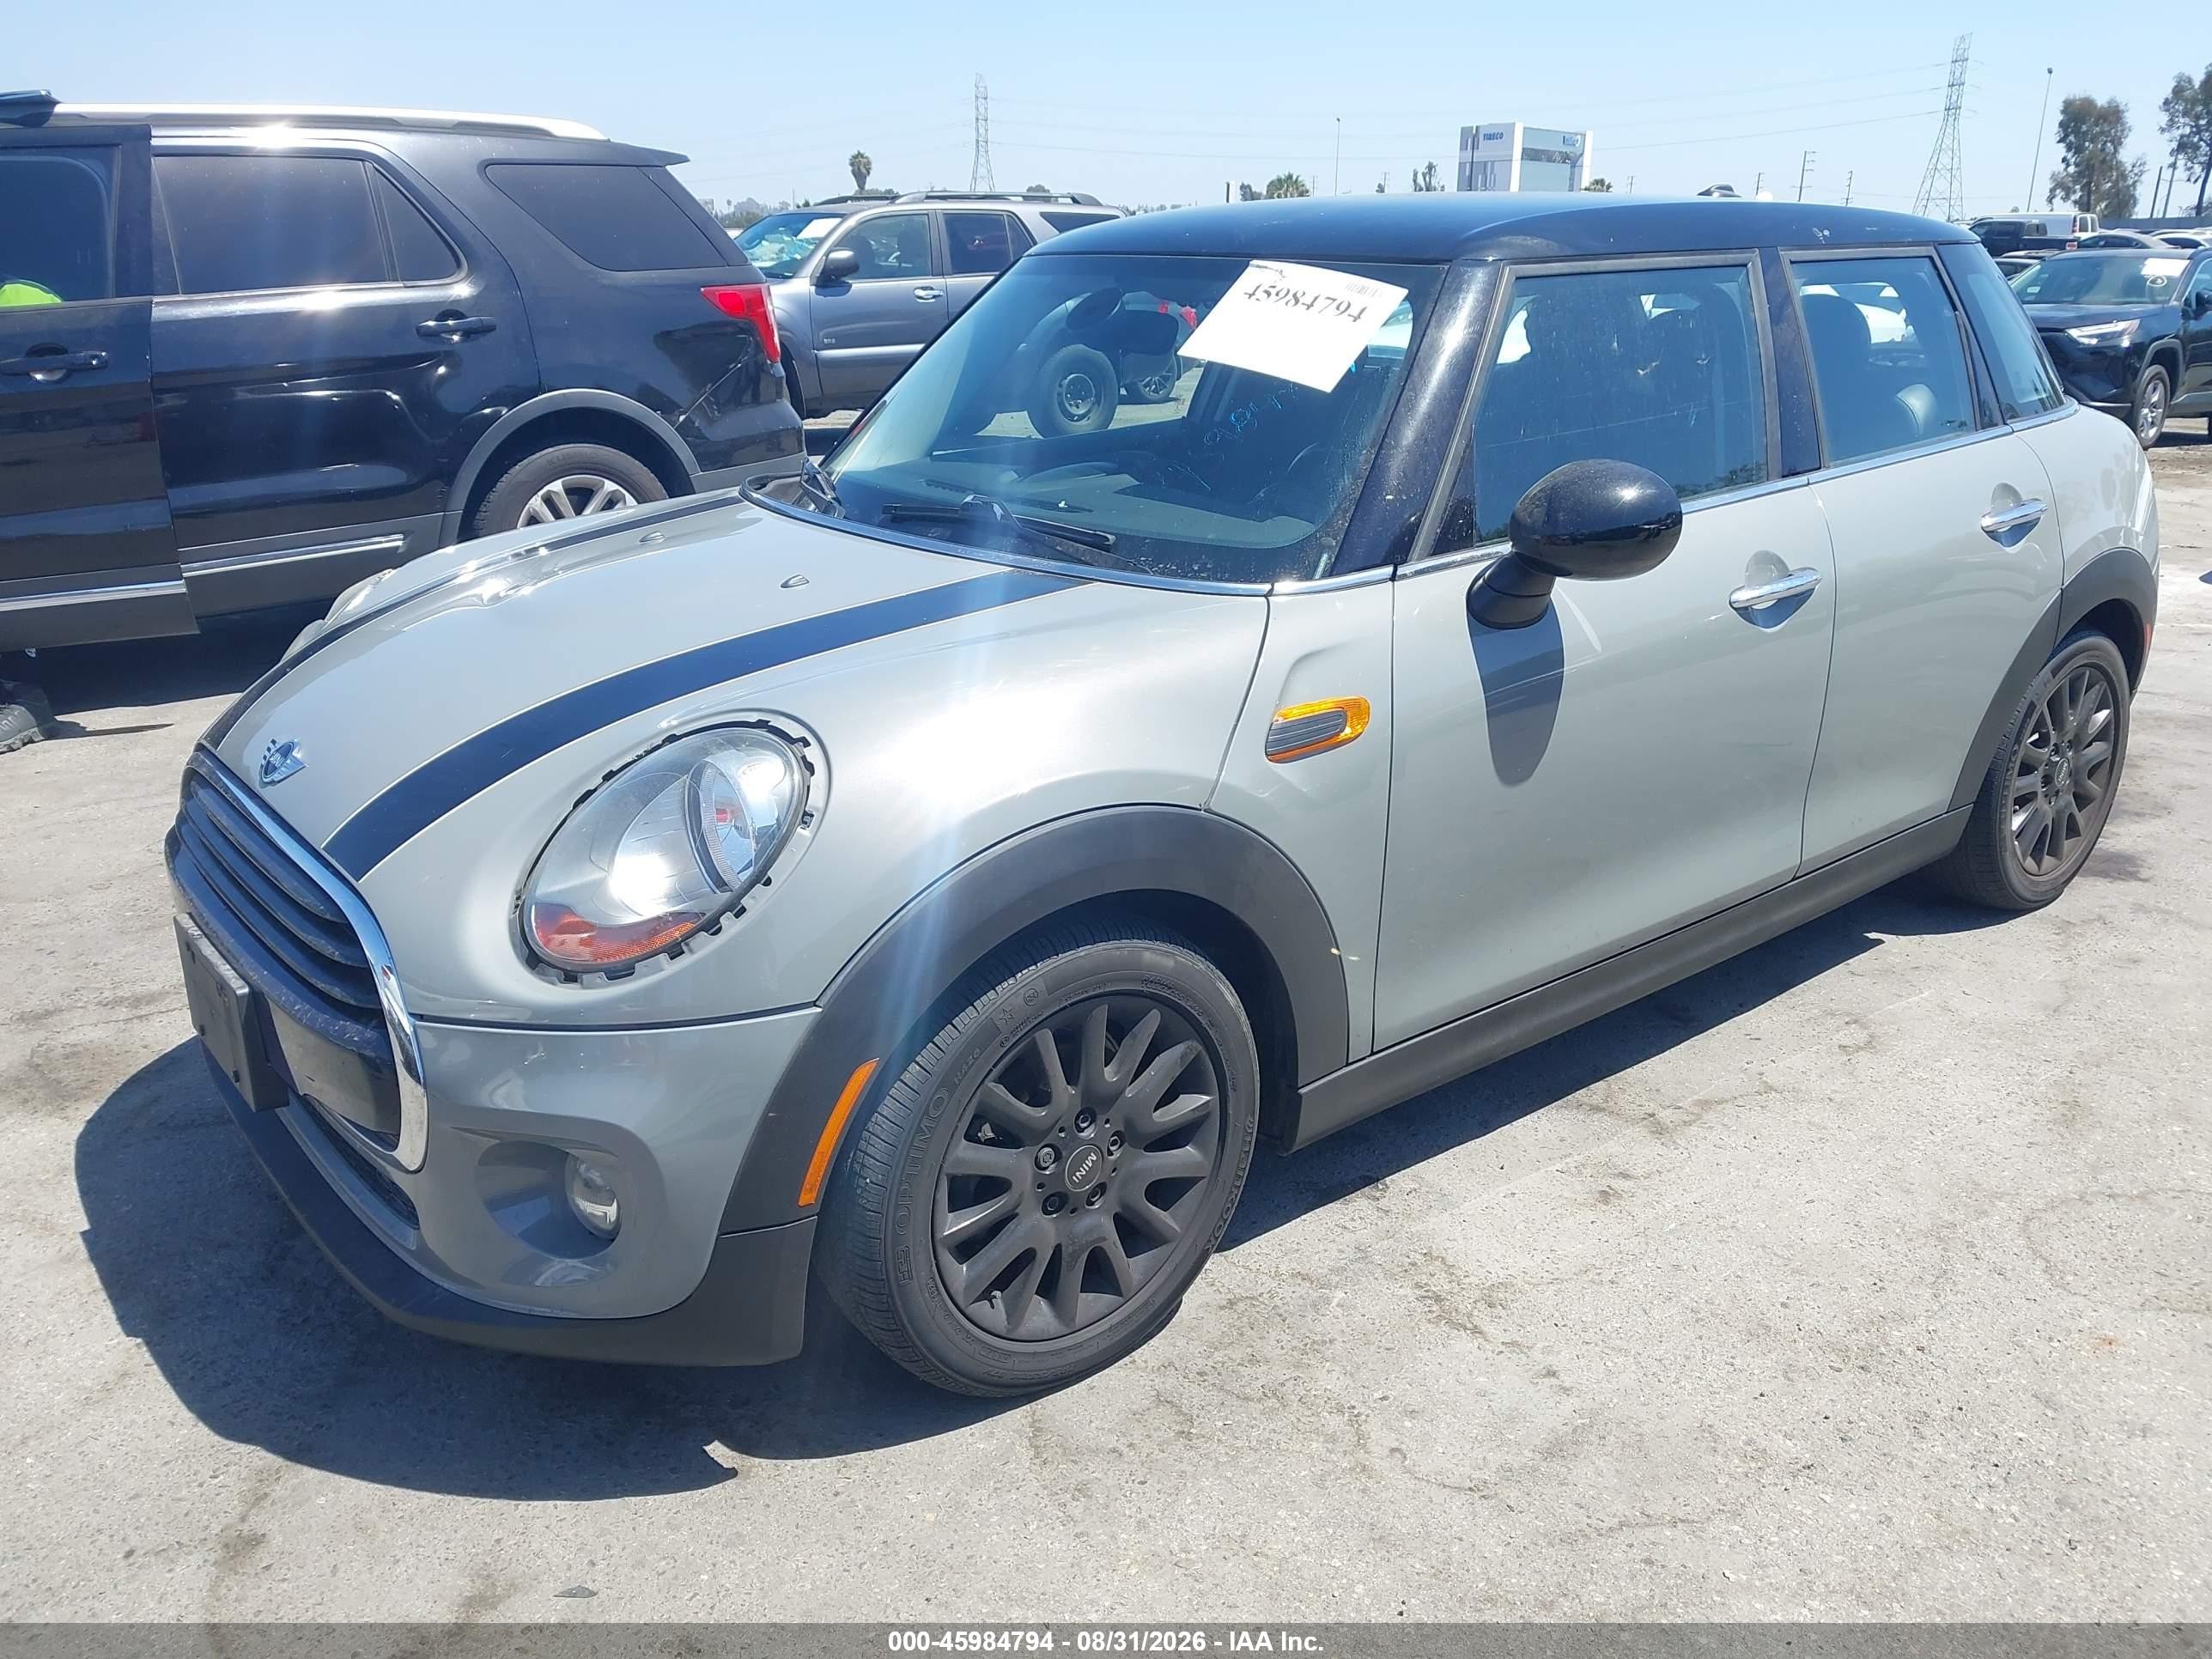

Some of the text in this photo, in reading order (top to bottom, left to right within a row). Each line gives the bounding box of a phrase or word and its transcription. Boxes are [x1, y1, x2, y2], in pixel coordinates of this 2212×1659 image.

[1244, 282, 1367, 322] 45984794
[2057, 761, 2068, 784] MINI
[897, 1085, 951, 1238] OPTIMO
[1072, 1152, 1098, 1183] MINI
